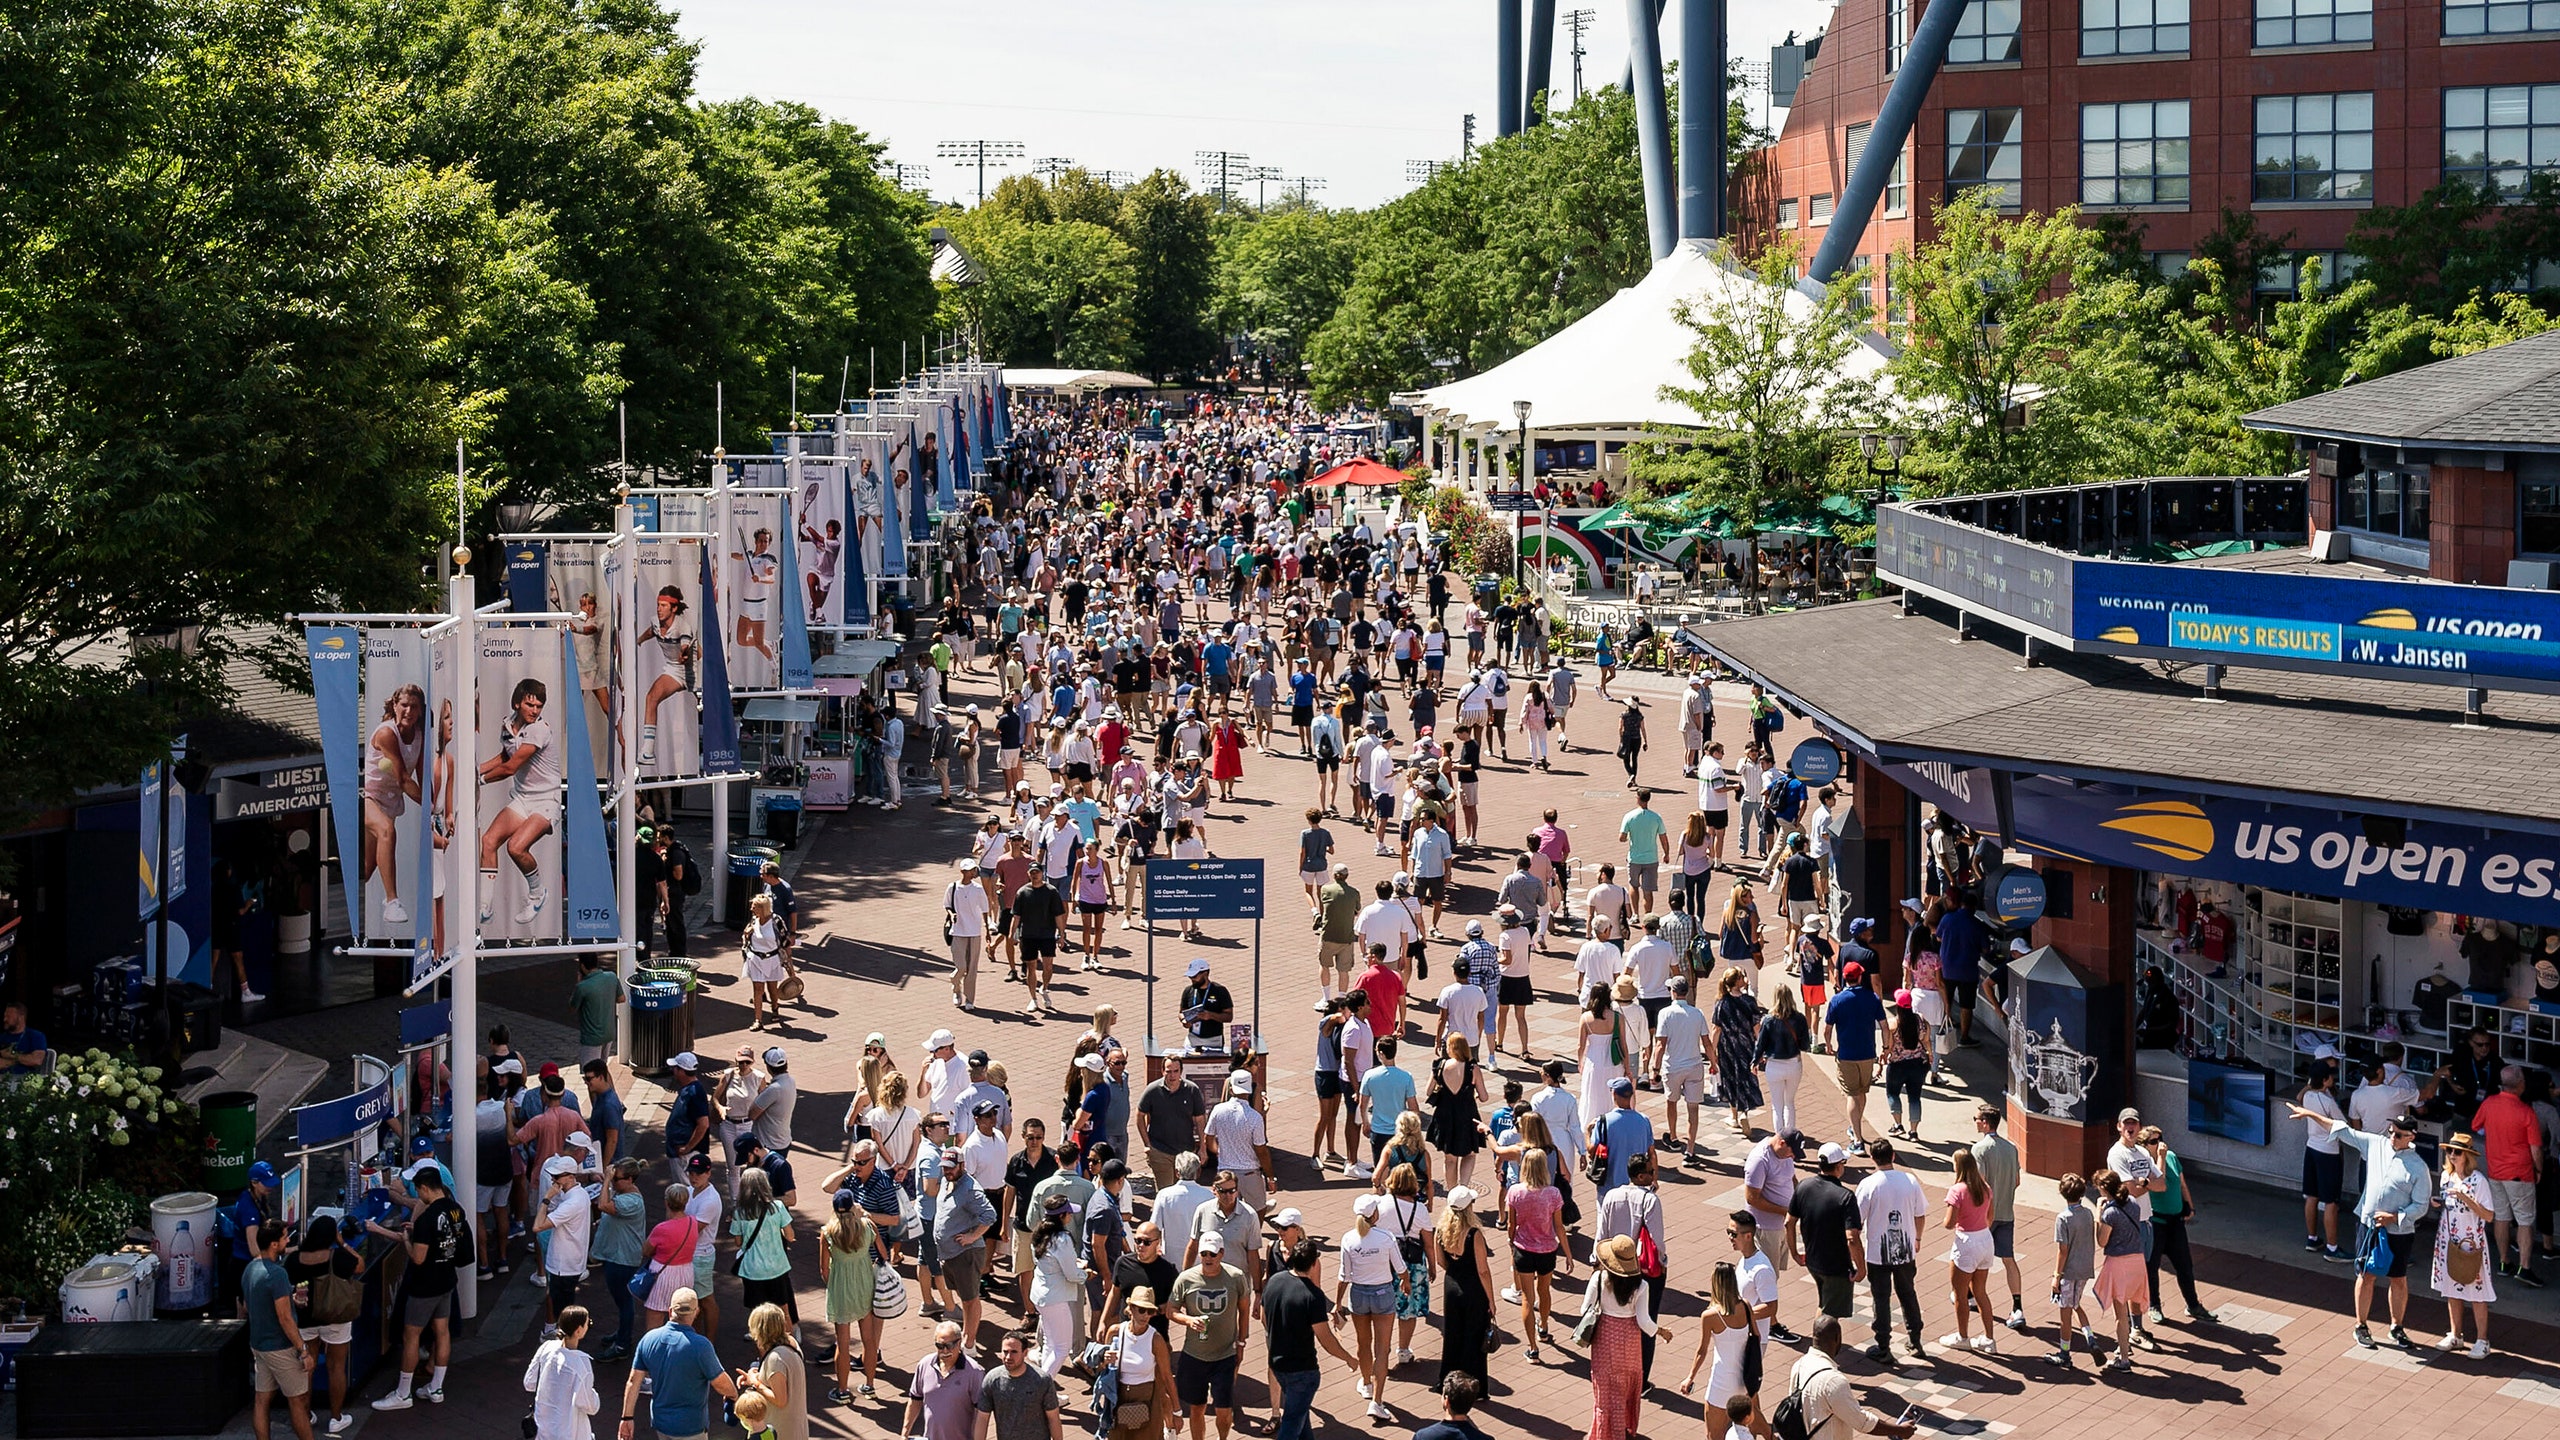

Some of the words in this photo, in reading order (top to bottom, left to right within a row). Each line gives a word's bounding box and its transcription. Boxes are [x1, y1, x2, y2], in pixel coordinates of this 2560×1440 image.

[640, 549, 659, 557] John
[523, 561, 540, 570] open
[553, 559, 595, 567] Navratilova
[640, 558, 672, 566] McEnroe
[1569, 604, 1629, 626] Heinek
[2425, 616, 2462, 635] us
[2464, 618, 2543, 641] open
[2176, 620, 2250, 646] TODAY'S
[2255, 626, 2332, 652] RESULTS
[368, 638, 393, 648] Tracy
[482, 638, 514, 648] Jimmy
[314, 651, 326, 660] us
[327, 651, 351, 662] open
[368, 649, 400, 658] Austin
[483, 648, 523, 658] Connors
[2391, 642, 2468, 670] Jansen
[709, 750, 735, 760] 1980
[810, 770, 837, 781] evian
[294, 784, 328, 795] HOSTED
[237, 793, 321, 817] AMERICAN
[2234, 822, 2303, 864] us
[2310, 831, 2467, 887] open
[2002, 894, 2042, 905] Performance
[577, 908, 610, 921] 1976
[576, 922, 610, 930] Champions
[355, 1096, 383, 1121] GREY
[178, 1257, 186, 1287] evian
